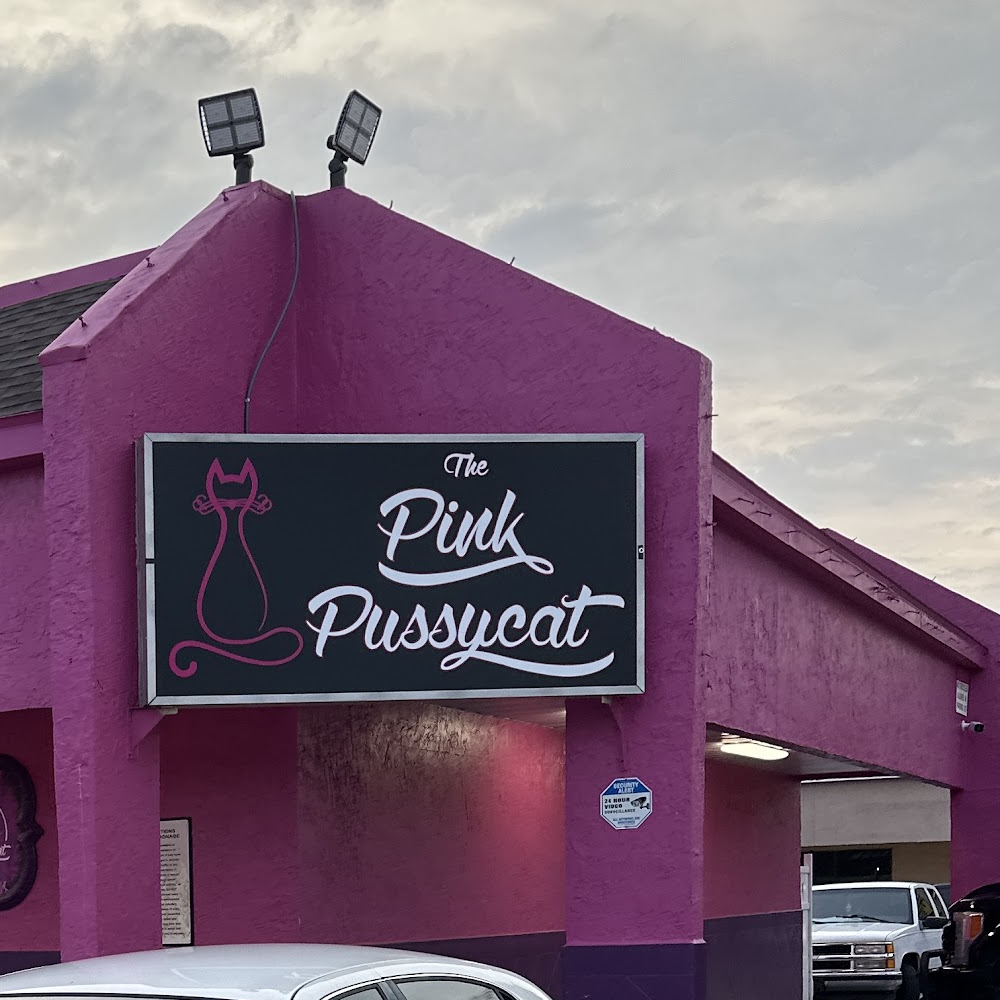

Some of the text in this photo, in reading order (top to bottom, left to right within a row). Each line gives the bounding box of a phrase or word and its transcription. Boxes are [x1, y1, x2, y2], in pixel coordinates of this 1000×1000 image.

[444, 453, 489, 477] The
[377, 489, 554, 586] Pink
[306, 585, 625, 678] Pussycat
